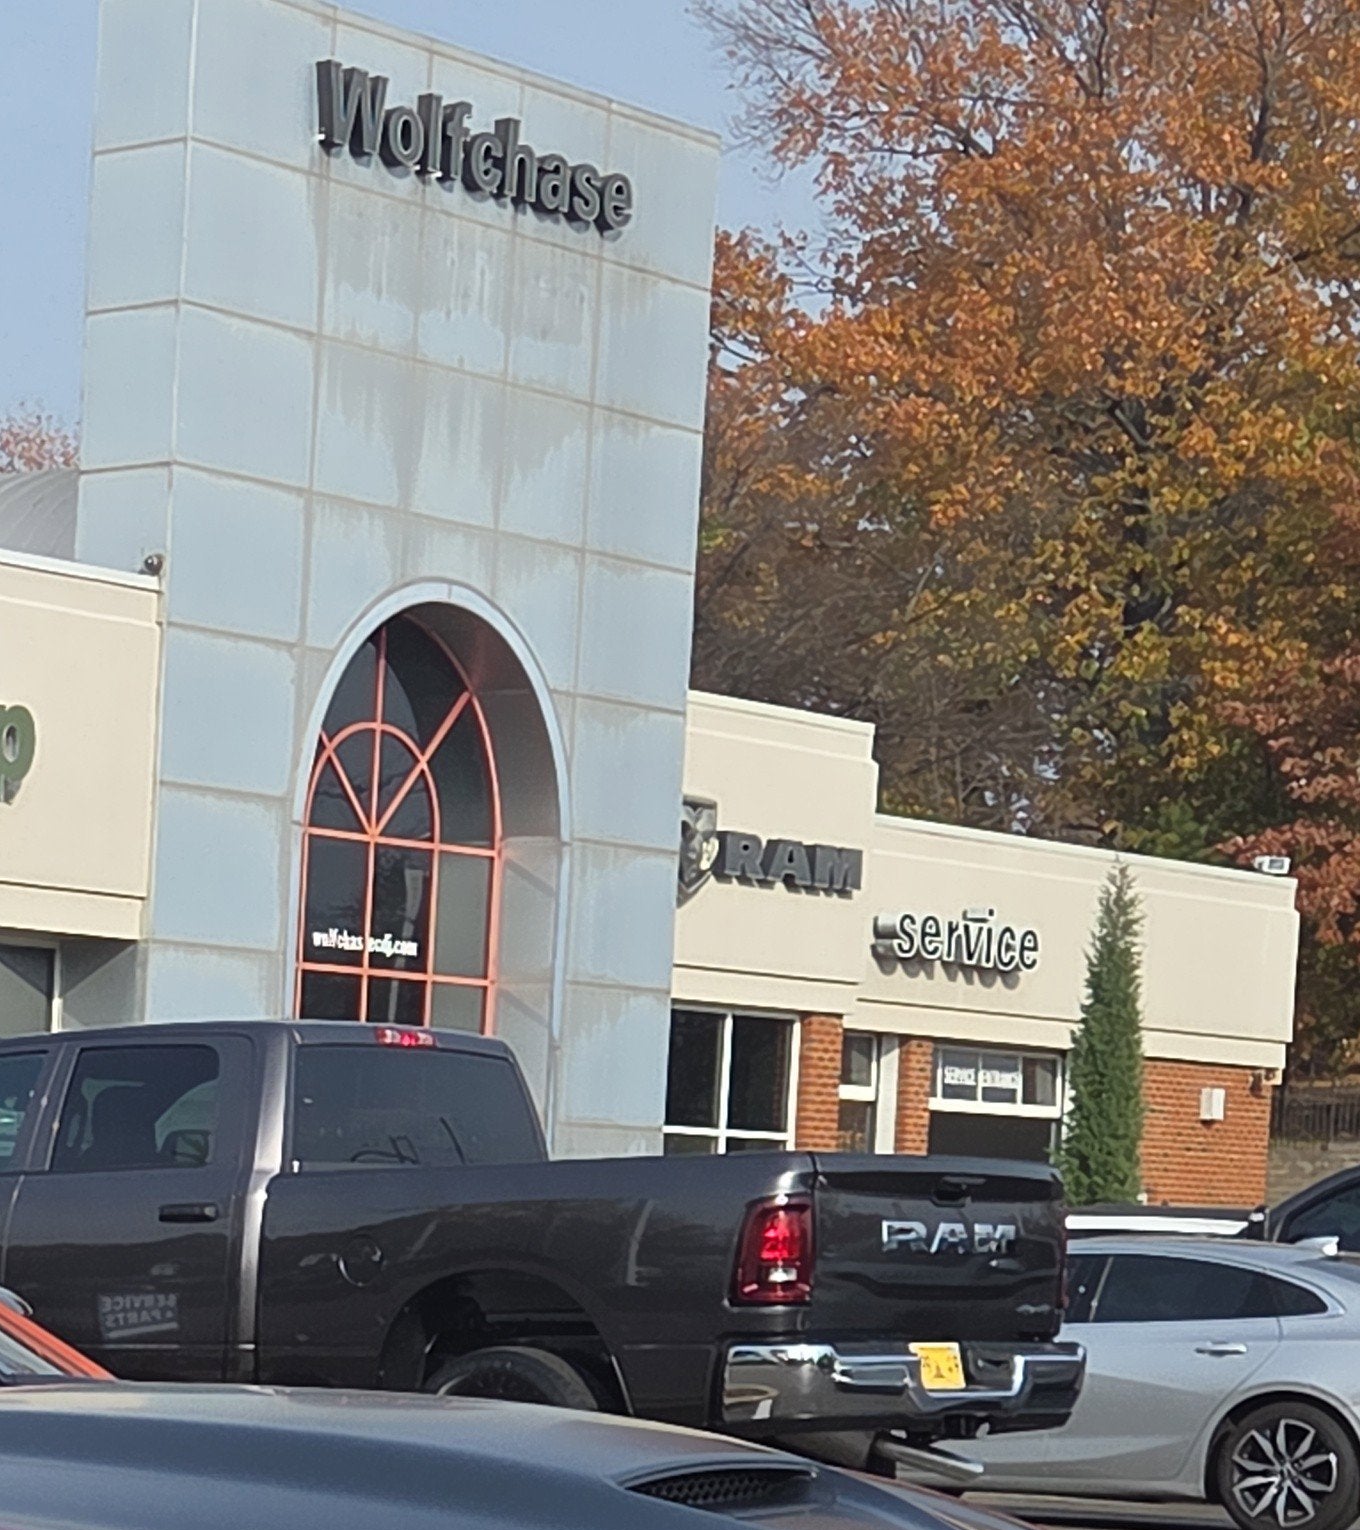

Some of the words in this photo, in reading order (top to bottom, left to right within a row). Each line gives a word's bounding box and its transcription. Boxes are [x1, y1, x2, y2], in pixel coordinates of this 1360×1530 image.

[316, 59, 634, 231] Wolfchase
[718, 831, 862, 890] RAM
[890, 908, 1039, 971] service
[882, 1220, 1016, 1254] RAM
